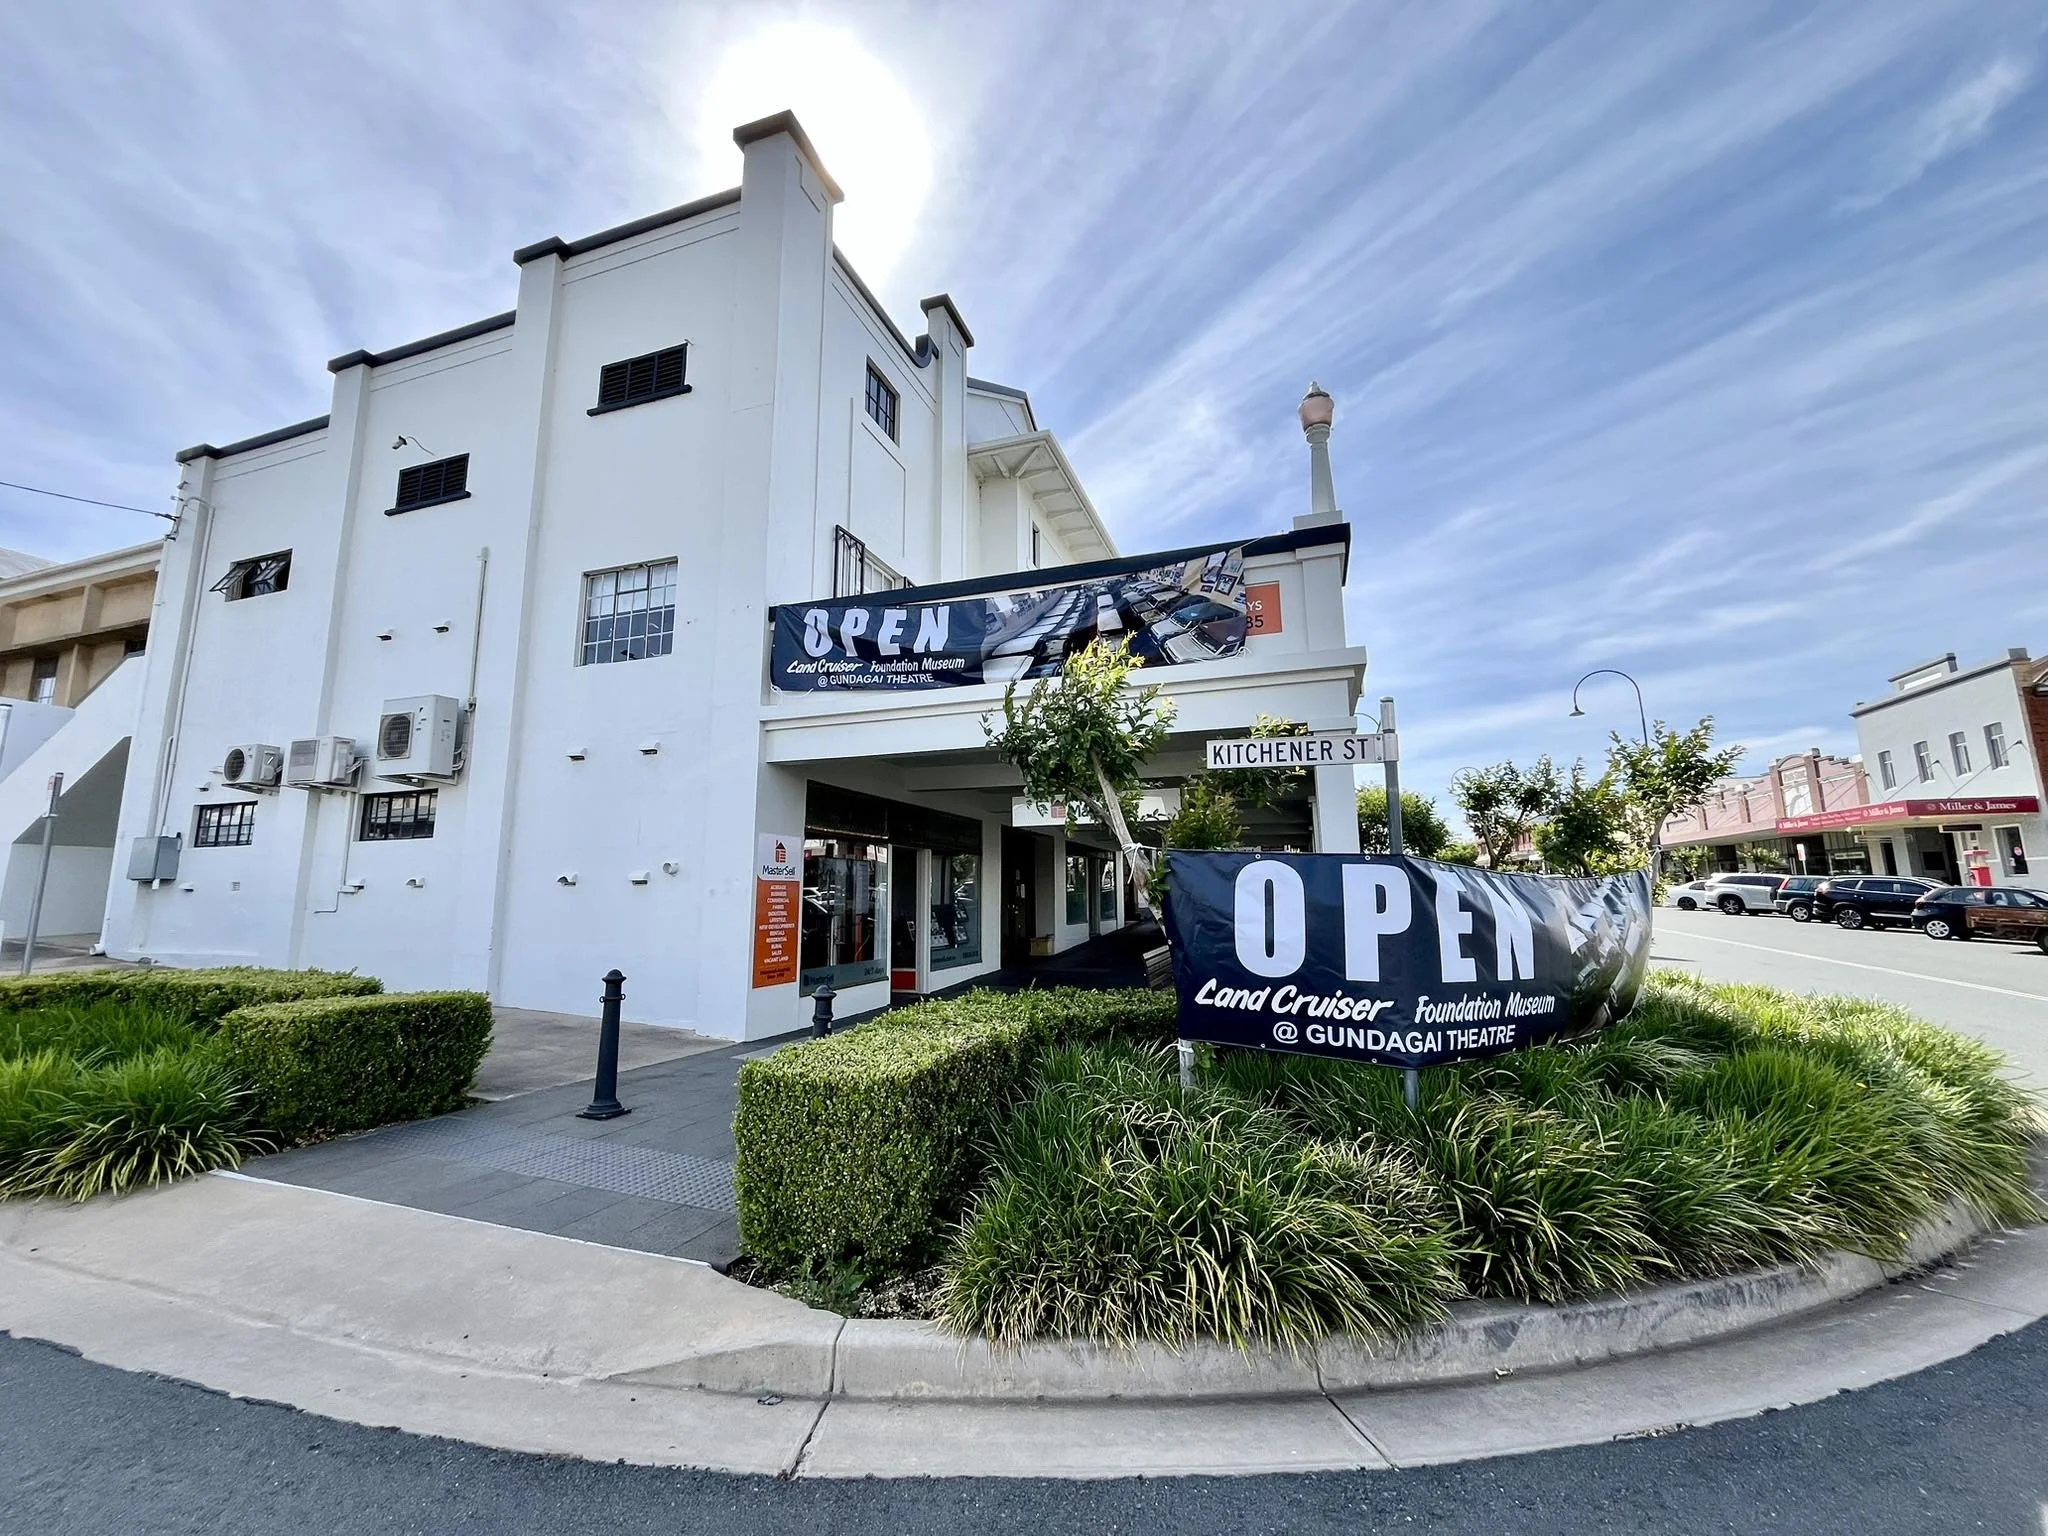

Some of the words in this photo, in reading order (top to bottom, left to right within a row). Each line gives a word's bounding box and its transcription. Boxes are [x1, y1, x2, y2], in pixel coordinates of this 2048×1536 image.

[803, 605, 950, 657] OPEN
[871, 658, 919, 673] Foundation
[922, 656, 966, 670] Museum
[817, 675, 828, 688] @
[829, 674, 884, 686] GUNDAGAI
[886, 672, 935, 684] THEATRE
[1213, 739, 1334, 766] KITCHENER
[1343, 737, 1369, 761] ST
[1939, 802, 1973, 811] Miller
[1973, 803, 1985, 811] &
[1985, 801, 2017, 811] James
[762, 865, 796, 876] MasterSell
[1234, 860, 1535, 982] OPEN
[1415, 991, 1502, 1024] Foundation
[1504, 990, 1556, 1018] Museum
[1272, 1021, 1299, 1044] @
[1306, 1024, 1443, 1053] GUNDAGAI
[1445, 1024, 1516, 1052] THEATRE
